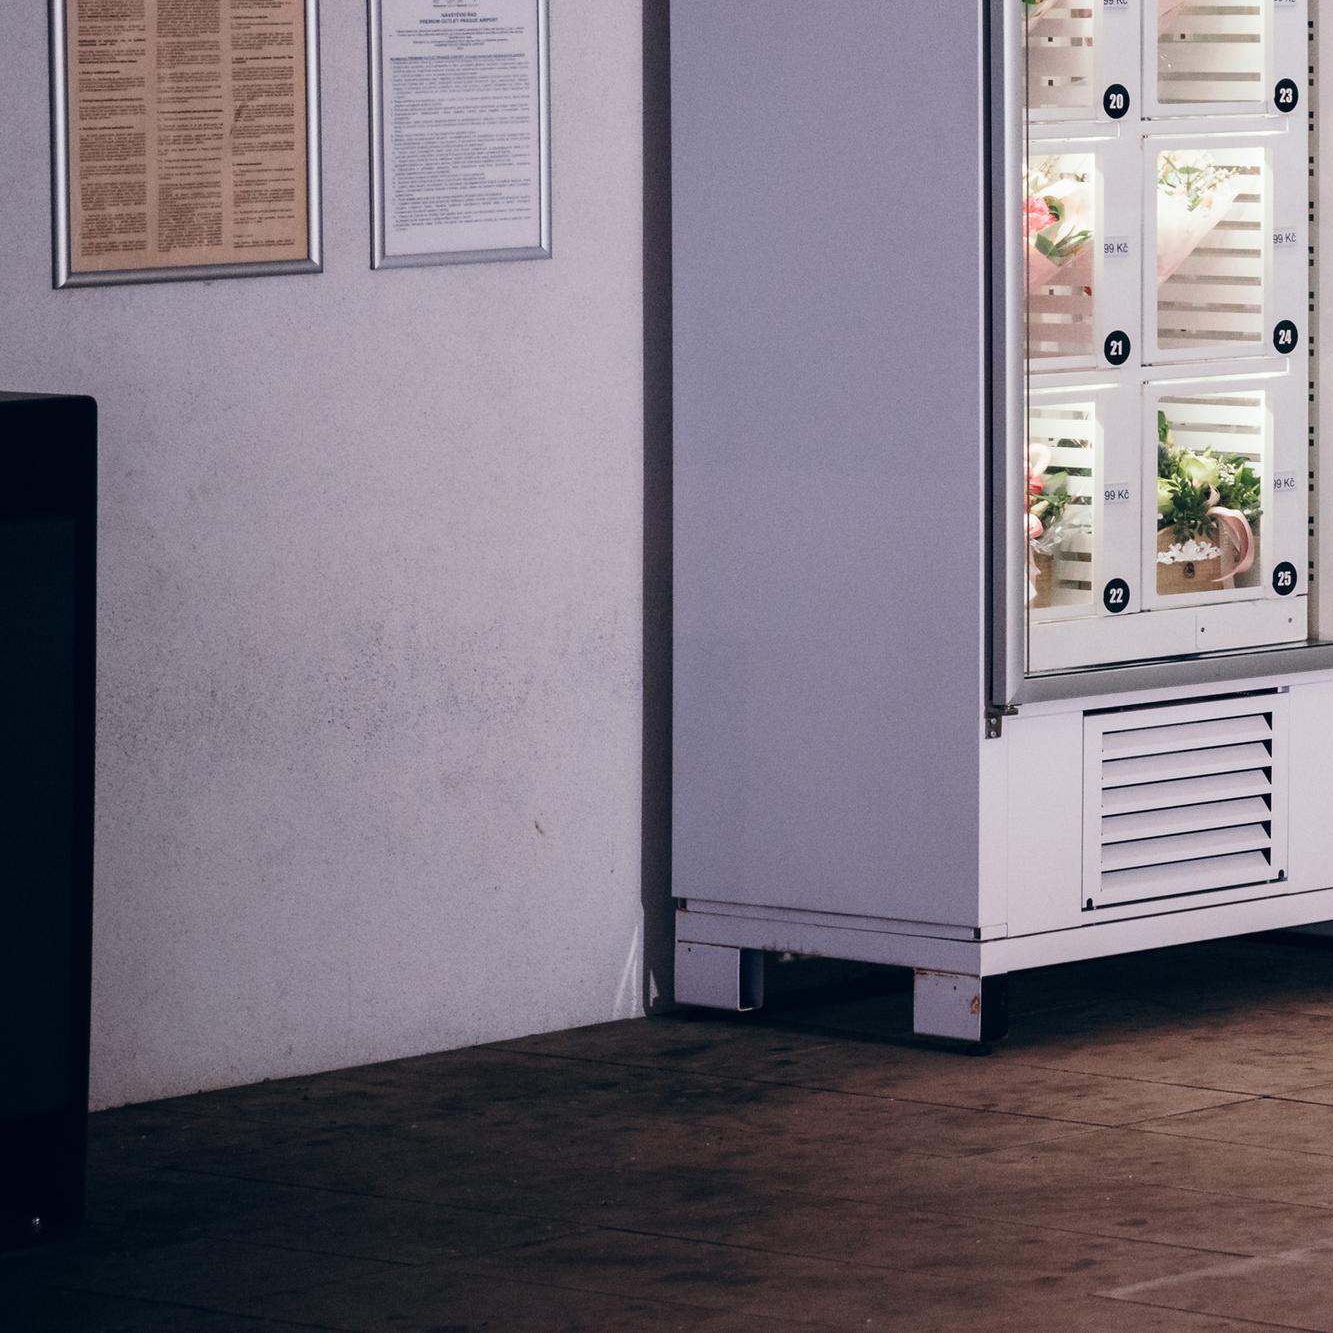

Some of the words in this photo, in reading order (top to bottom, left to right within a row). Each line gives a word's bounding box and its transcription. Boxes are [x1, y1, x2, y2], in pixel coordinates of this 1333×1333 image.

[1109, 93, 1124, 109] 20
[1279, 87, 1293, 103] 23
[1284, 232, 1297, 243] Kč
[1116, 242, 1129, 253] Kč
[1279, 329, 1292, 344] 24
[1110, 340, 1123, 356] 21
[1284, 477, 1295, 488] Kč
[1117, 488, 1130, 500] Kč
[1277, 571, 1292, 586] 25
[1109, 587, 1124, 603] 22
